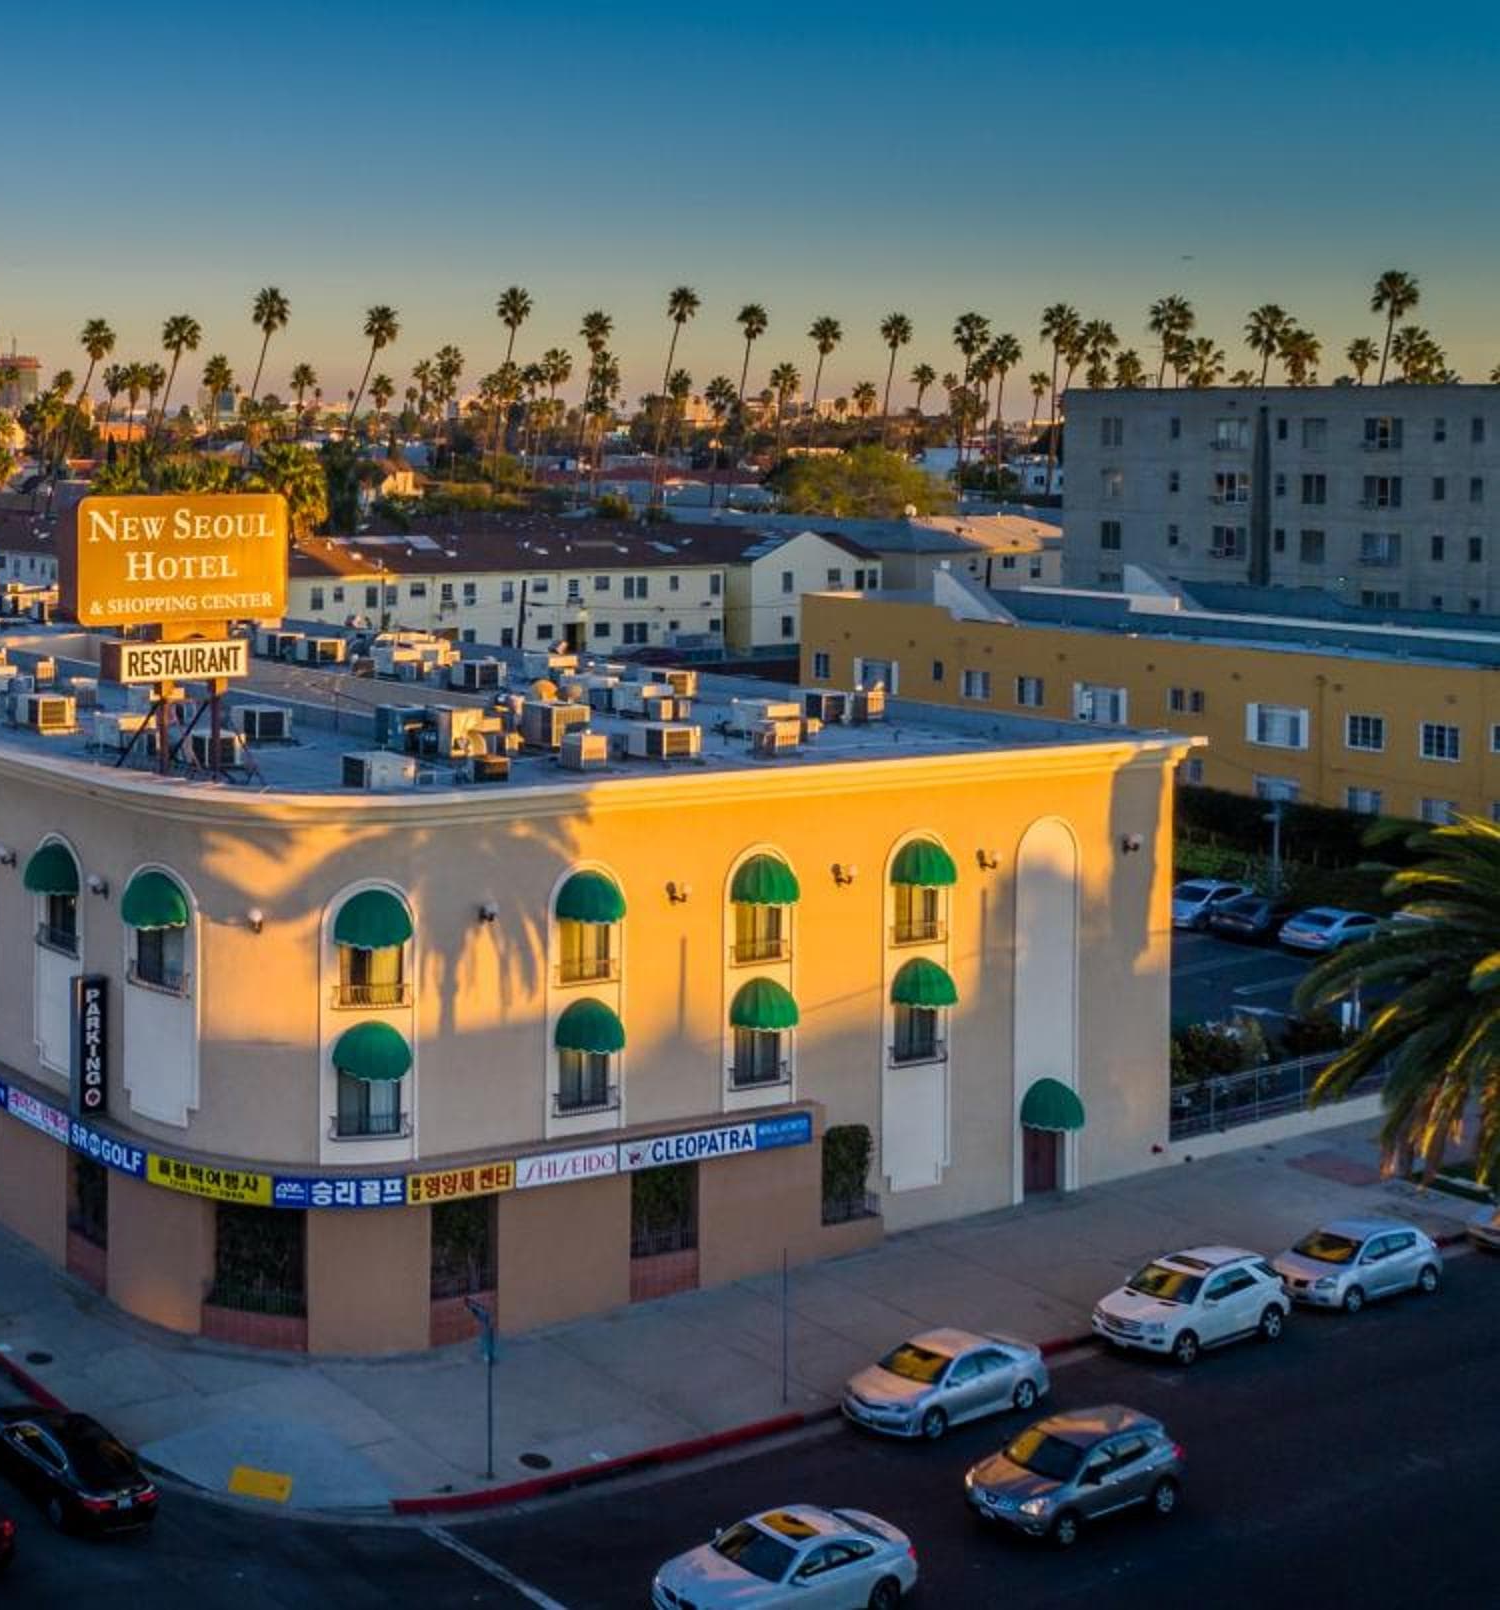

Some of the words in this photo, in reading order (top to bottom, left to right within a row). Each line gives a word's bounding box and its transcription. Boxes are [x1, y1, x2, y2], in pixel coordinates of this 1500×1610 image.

[88, 509, 167, 543] NEW
[172, 508, 275, 540] SEOUL
[125, 551, 238, 582] HOTEL
[89, 601, 103, 616] &
[107, 594, 197, 615] SHOPPING
[200, 592, 273, 611] CENTER
[126, 646, 242, 678] RESTAURANT
[85, 988, 101, 1086] PARKING
[101, 1139, 143, 1173] GOLF
[651, 1127, 754, 1163] CLEOPATRA
[523, 1151, 616, 1184] SHISEIDO
